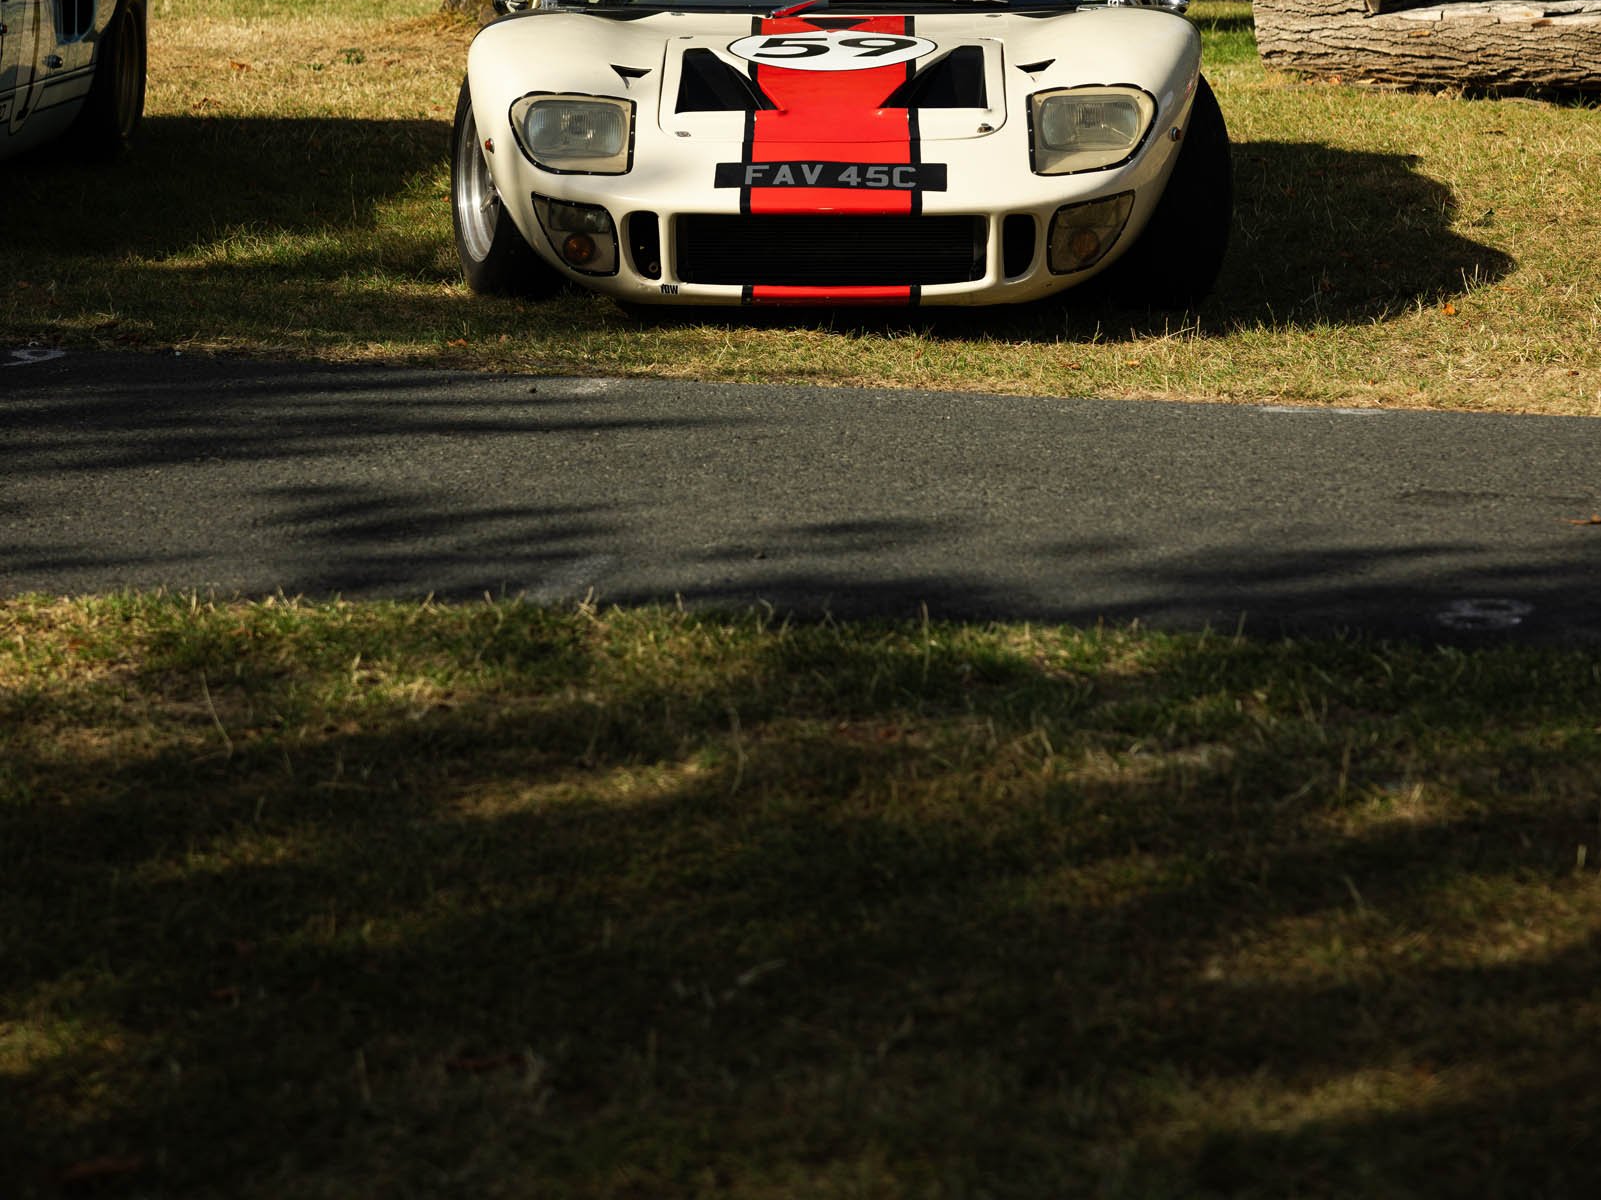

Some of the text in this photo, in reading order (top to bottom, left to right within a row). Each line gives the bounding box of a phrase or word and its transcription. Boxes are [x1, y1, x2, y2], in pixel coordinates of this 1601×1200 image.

[753, 37, 918, 58] 59
[744, 164, 917, 188] FAV 45C
